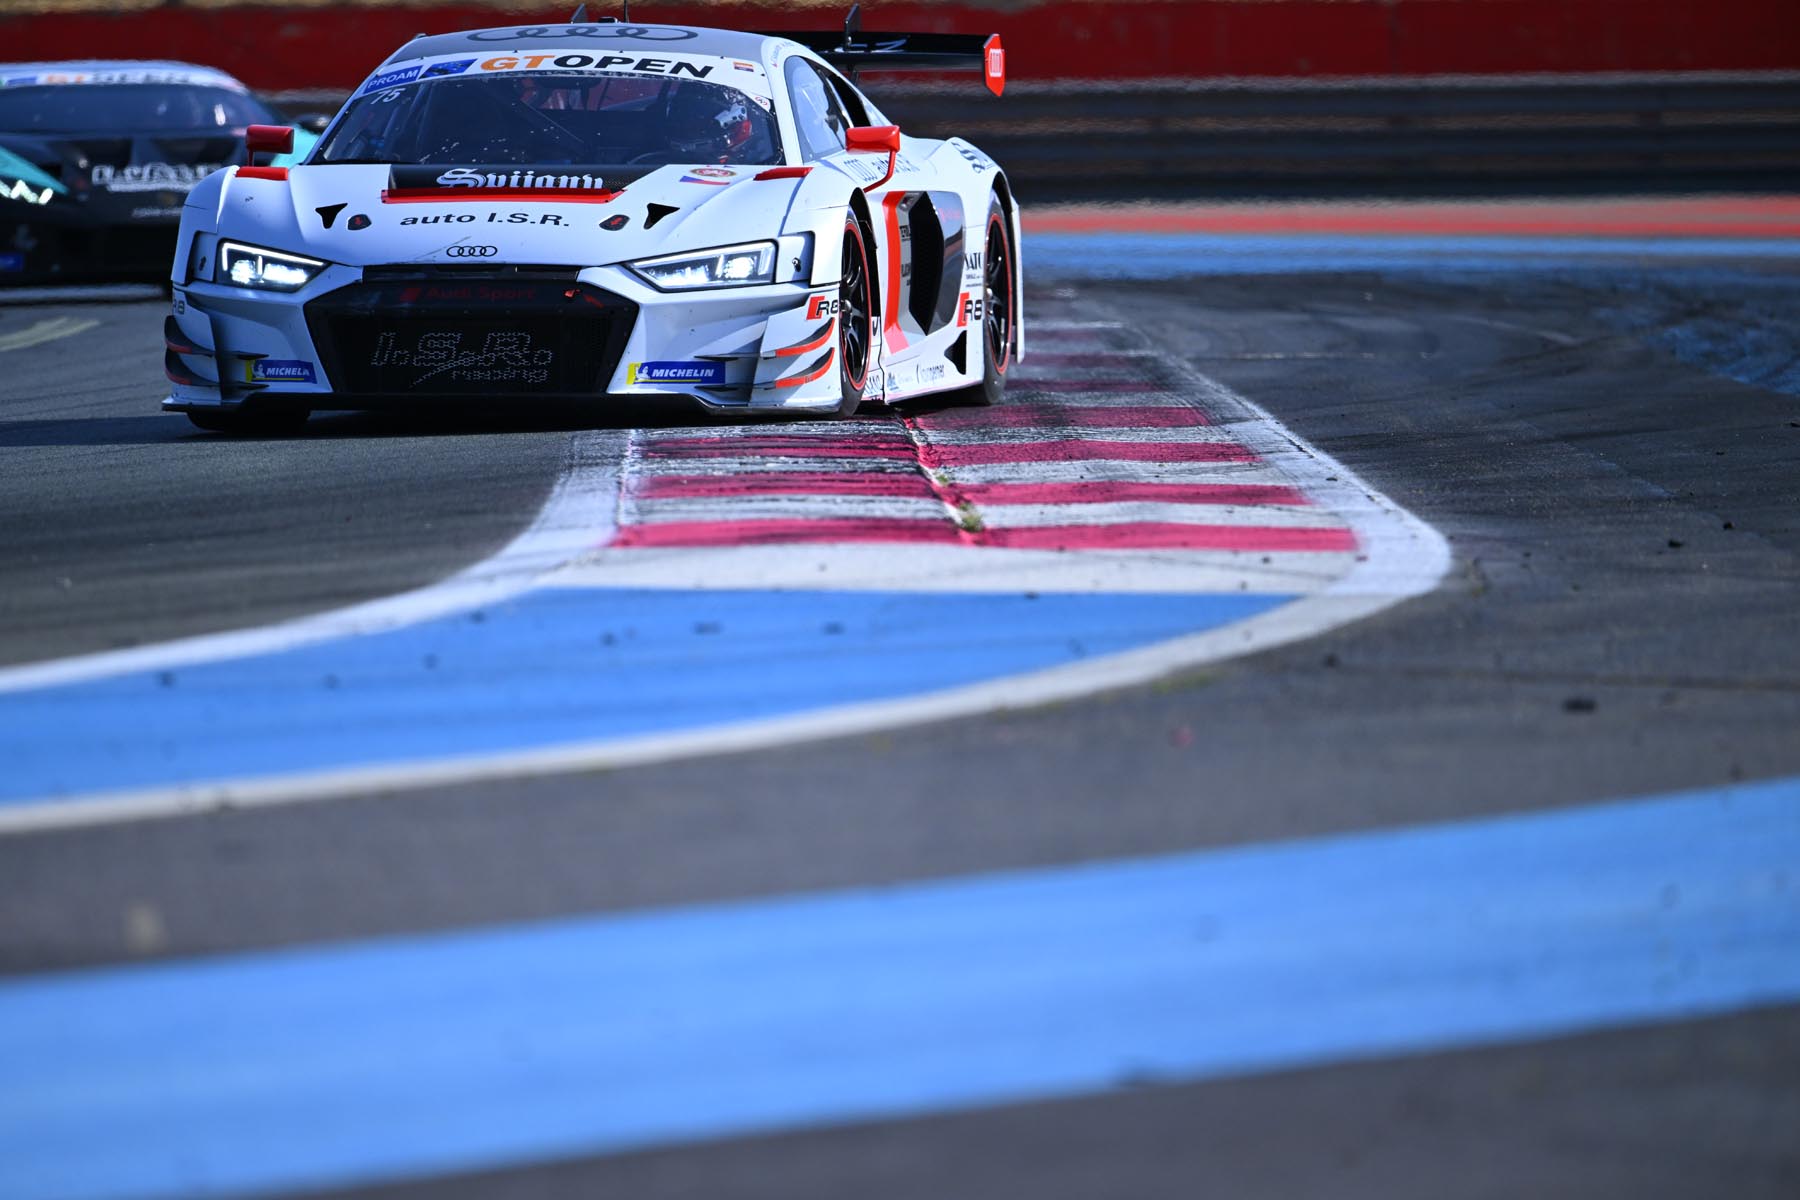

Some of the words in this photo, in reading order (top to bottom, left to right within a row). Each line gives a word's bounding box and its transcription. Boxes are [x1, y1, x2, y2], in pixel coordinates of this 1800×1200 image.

[367, 69, 419, 89] PROAM
[370, 88, 406, 105] 75
[399, 213, 477, 226] auto
[487, 212, 570, 227] I.S.R.
[479, 286, 537, 302] Sport
[815, 299, 839, 316] R8
[963, 299, 983, 321] R8
[651, 368, 715, 377] MICHELIN
